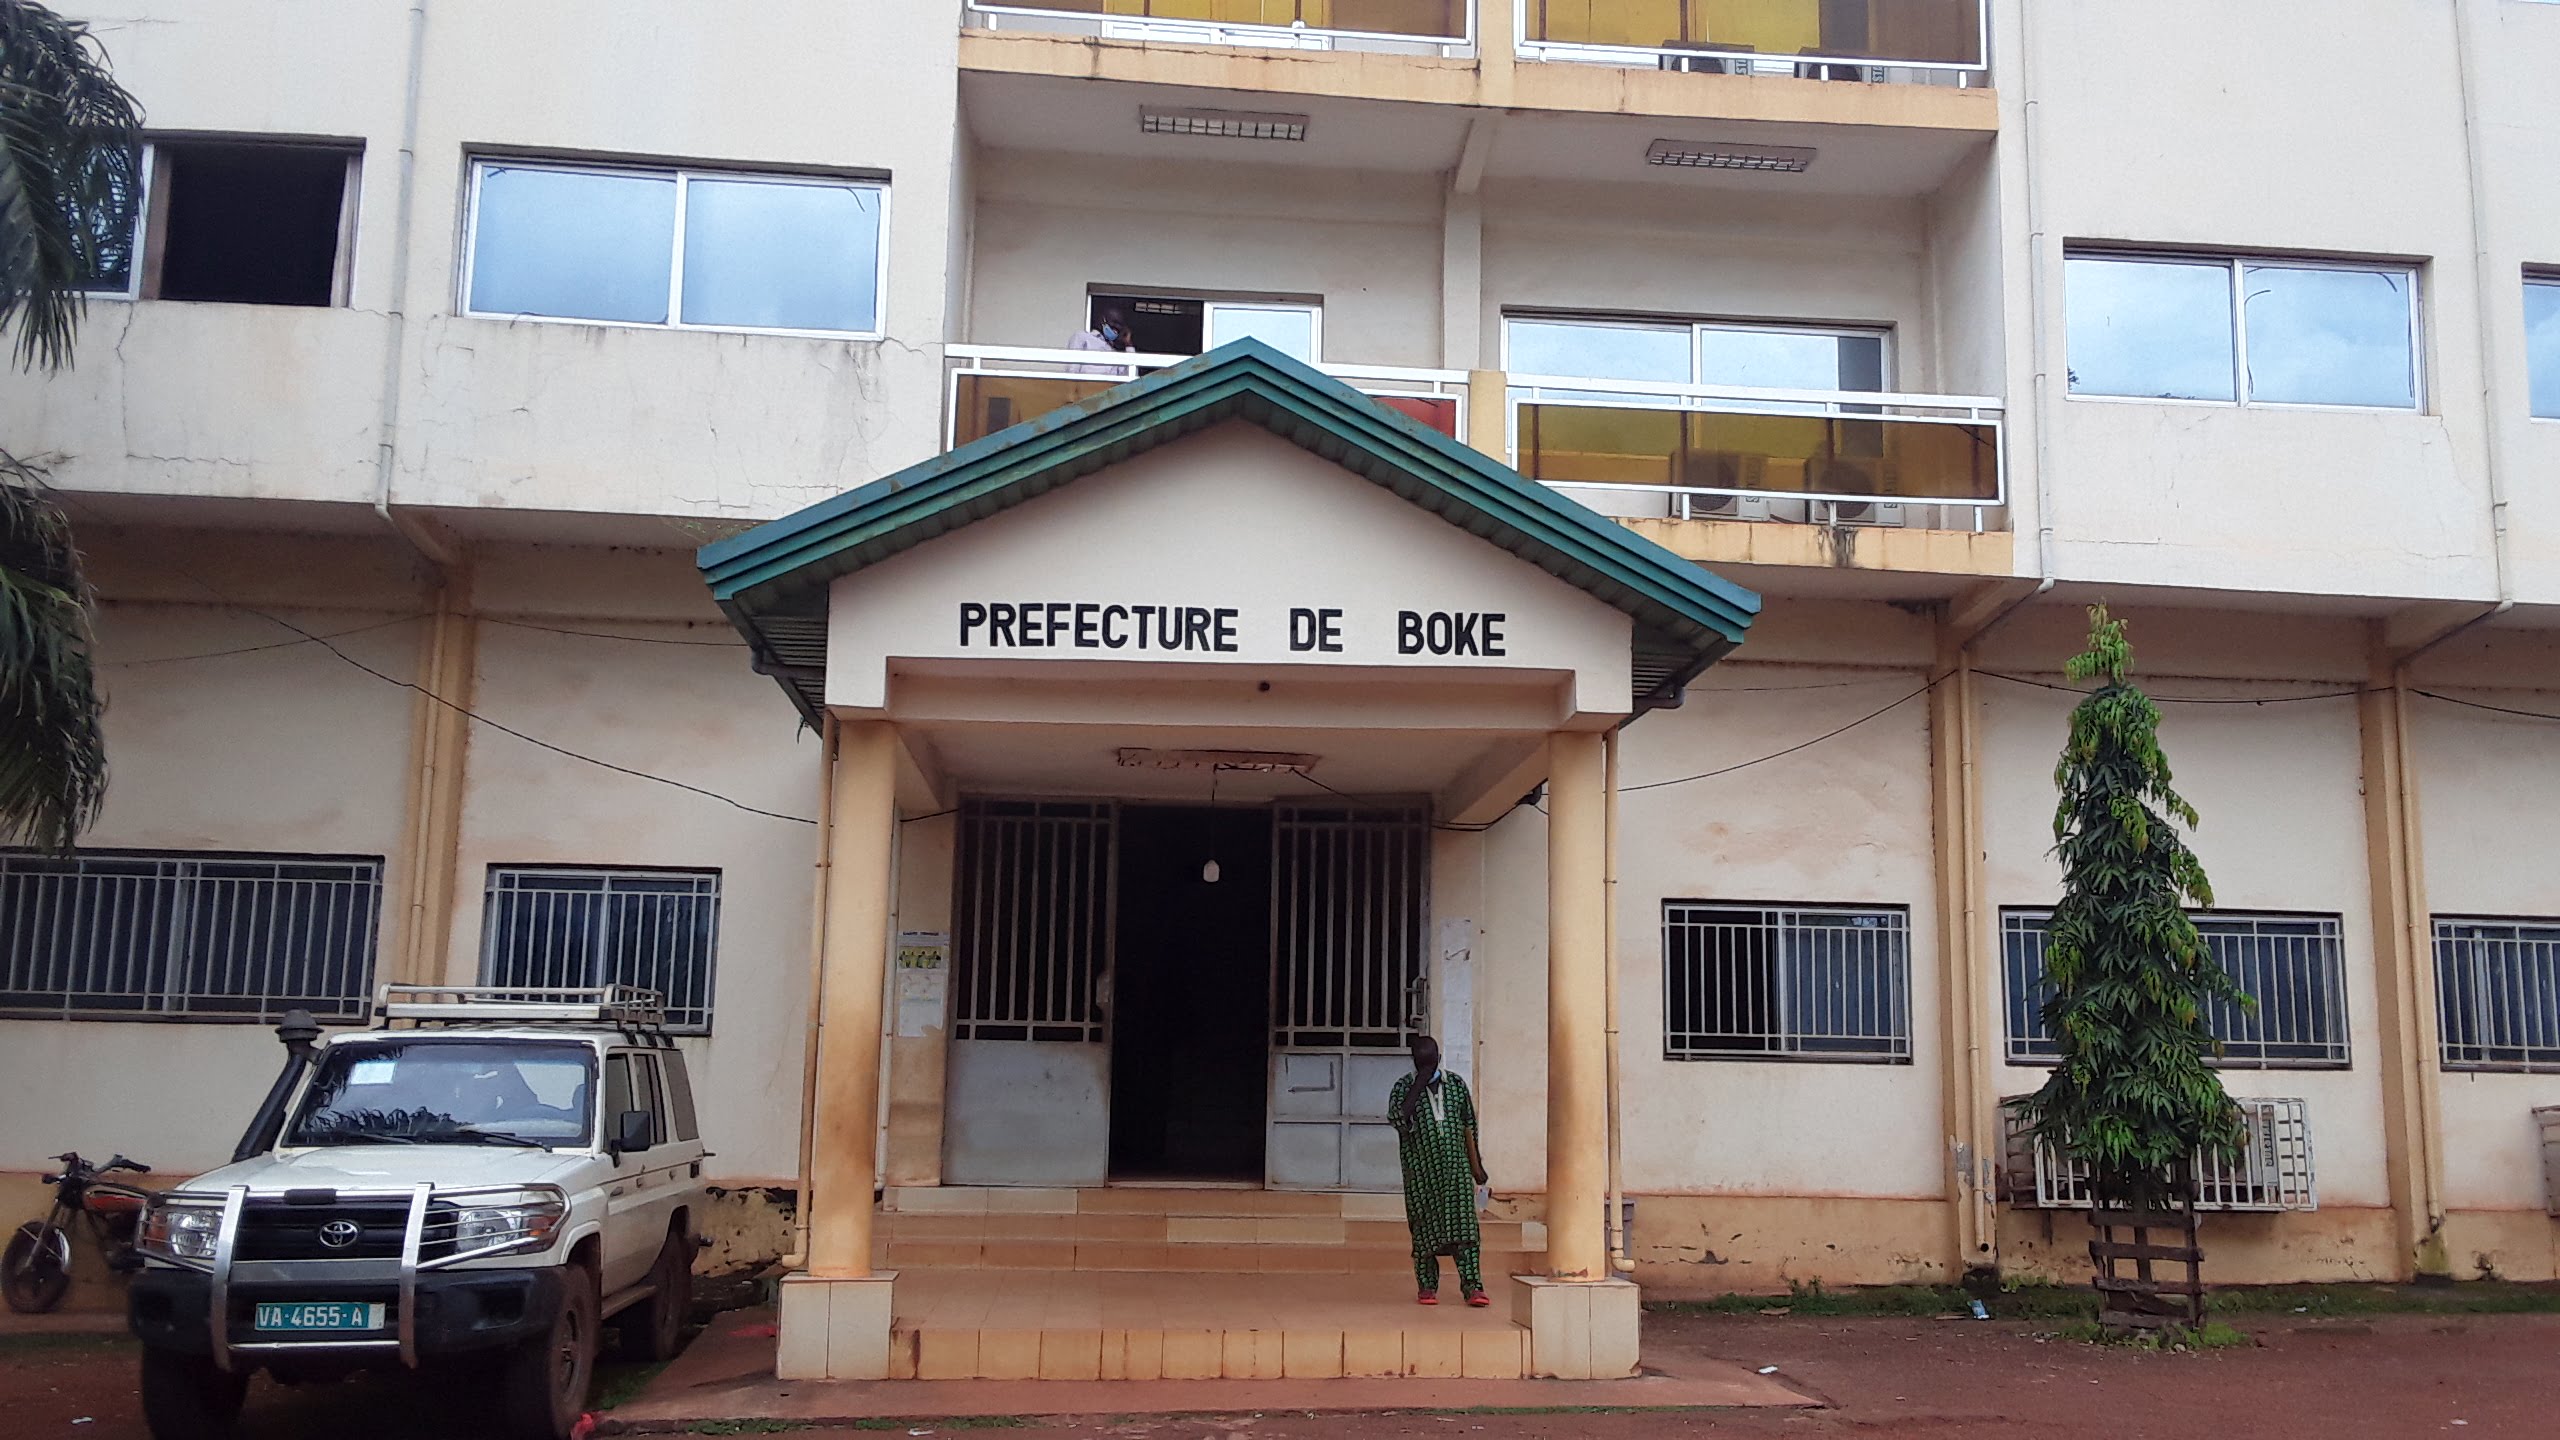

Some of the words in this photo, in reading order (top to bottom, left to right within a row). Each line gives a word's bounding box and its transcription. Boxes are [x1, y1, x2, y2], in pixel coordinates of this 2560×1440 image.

[960, 602, 1239, 652] PREFECTURE
[1289, 607, 1343, 653] DE
[1398, 610, 1506, 657] BOKE
